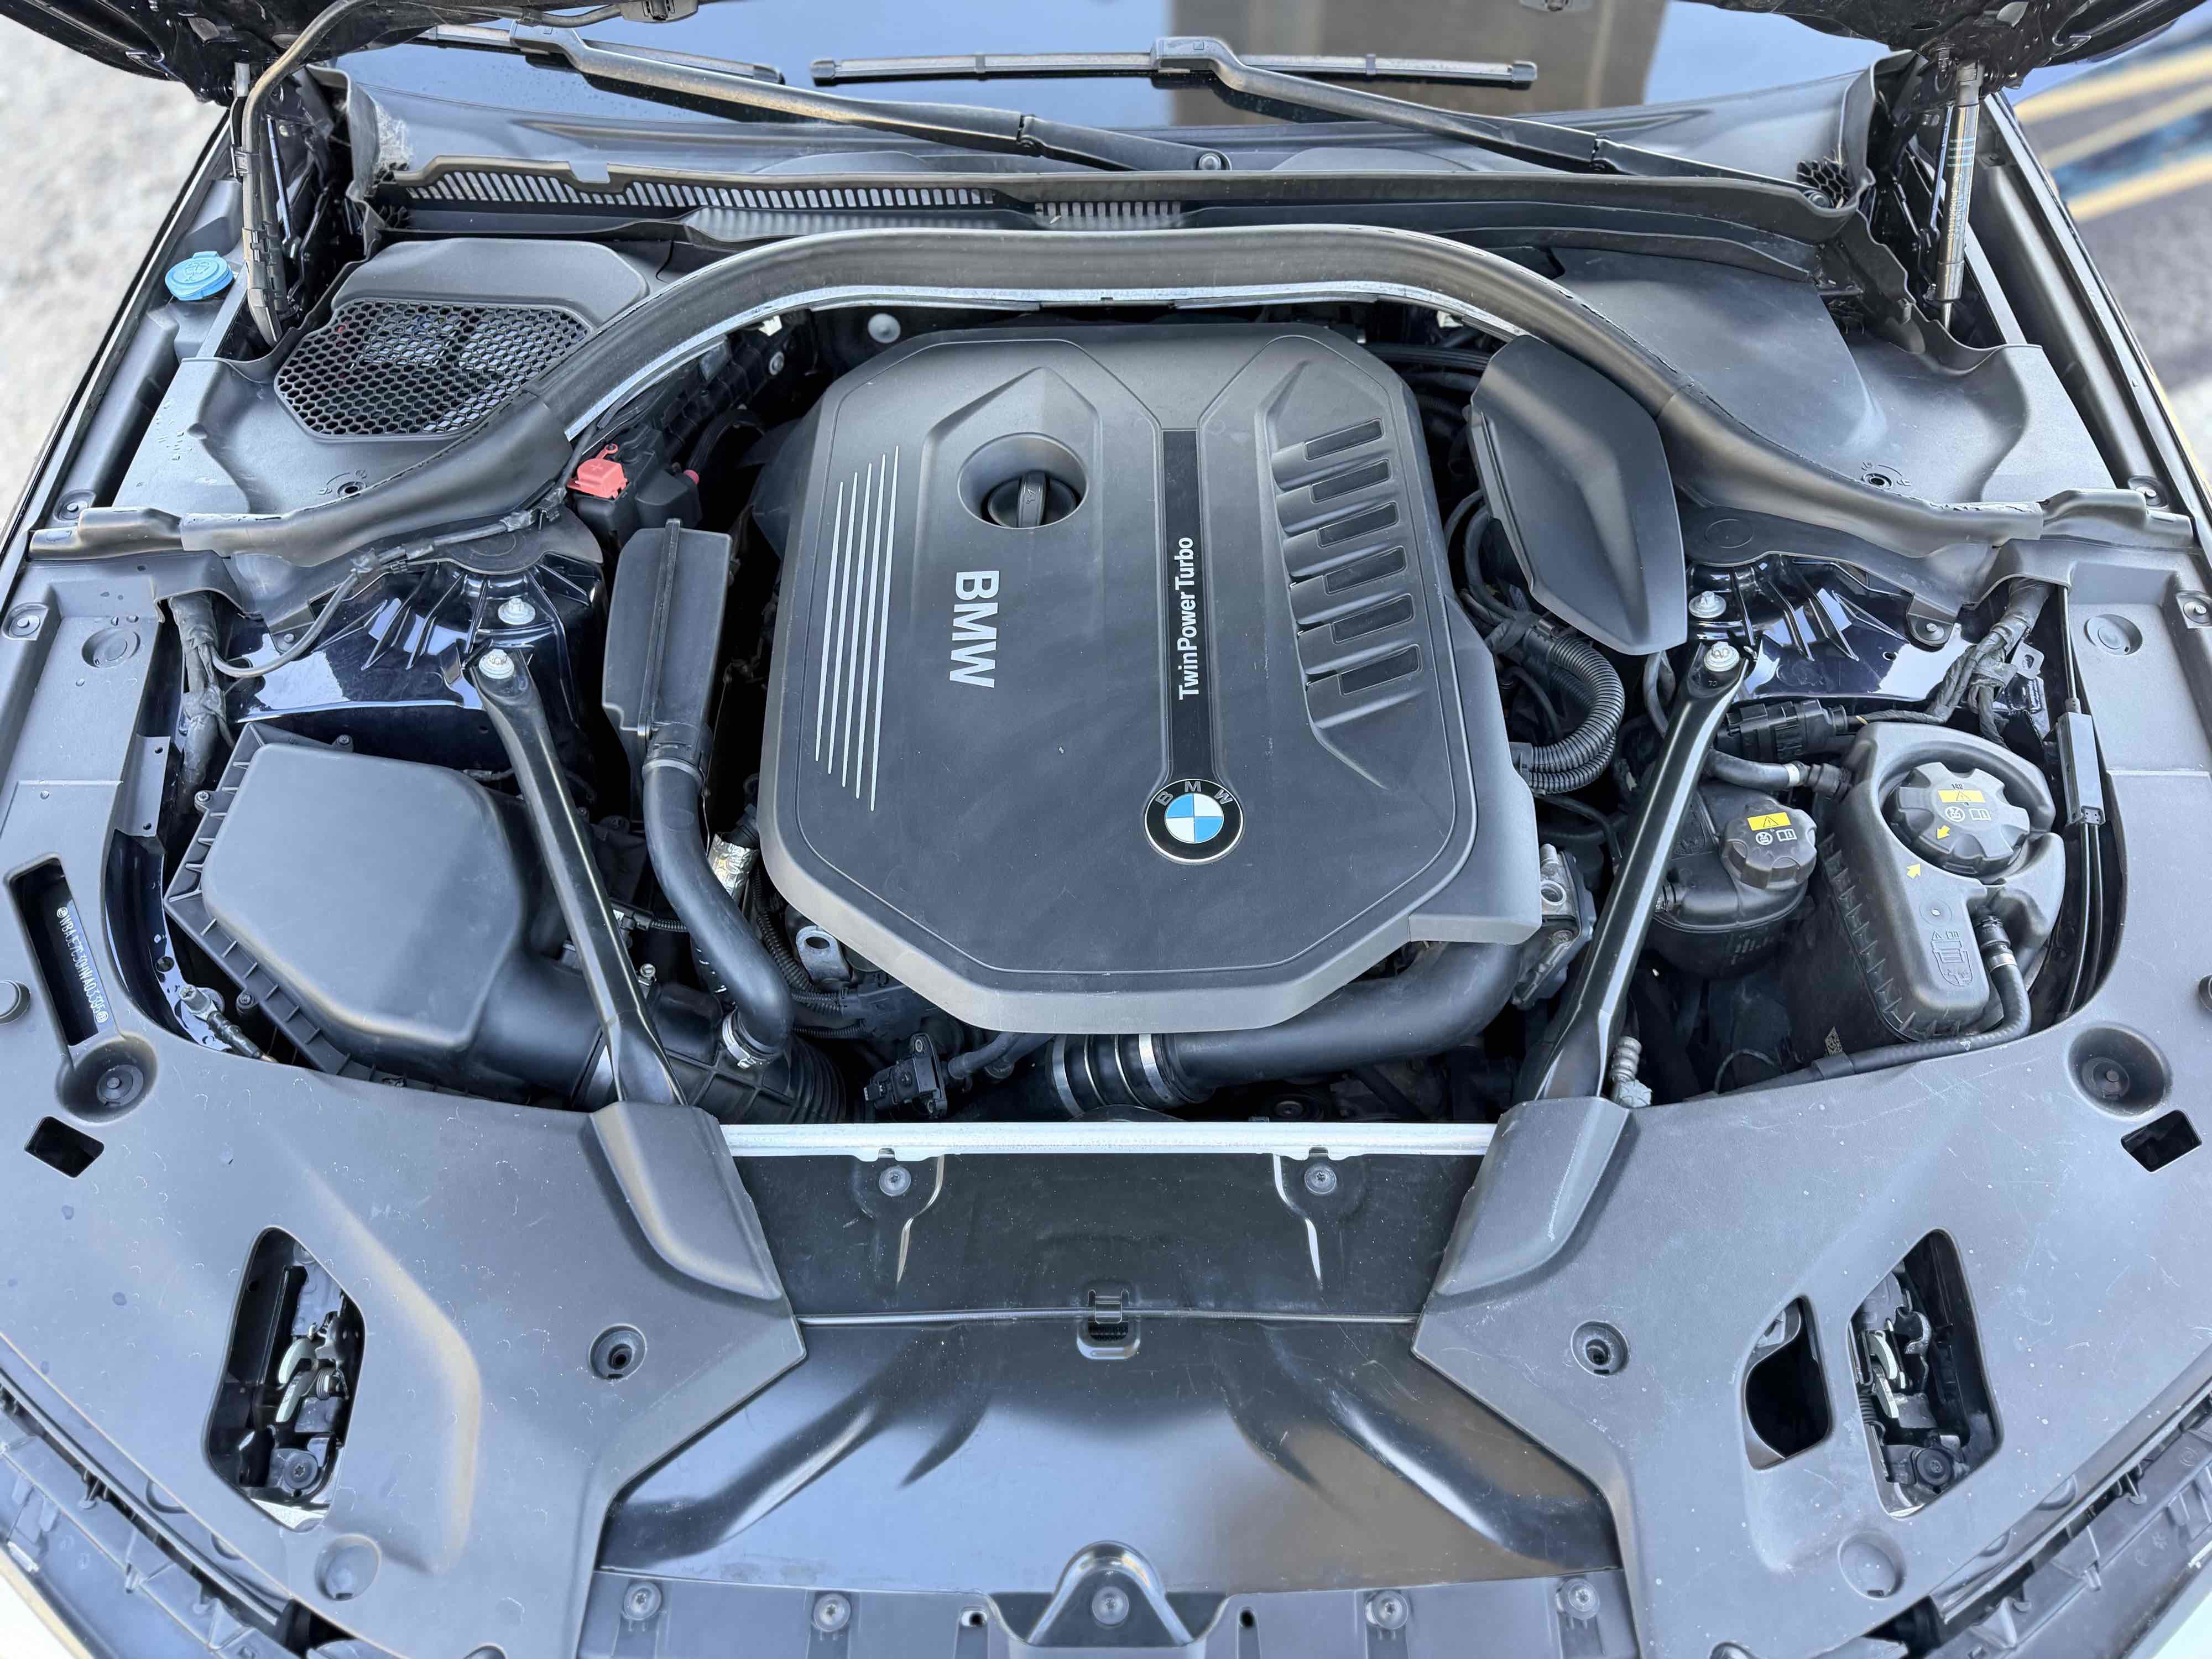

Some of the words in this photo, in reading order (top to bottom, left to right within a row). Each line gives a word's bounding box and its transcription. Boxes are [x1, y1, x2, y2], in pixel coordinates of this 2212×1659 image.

[1174, 537, 1194, 591] Turbo
[950, 570, 1000, 688] BMW
[1177, 592, 1199, 700] TwinPower
[1155, 781, 1233, 806] BMW
